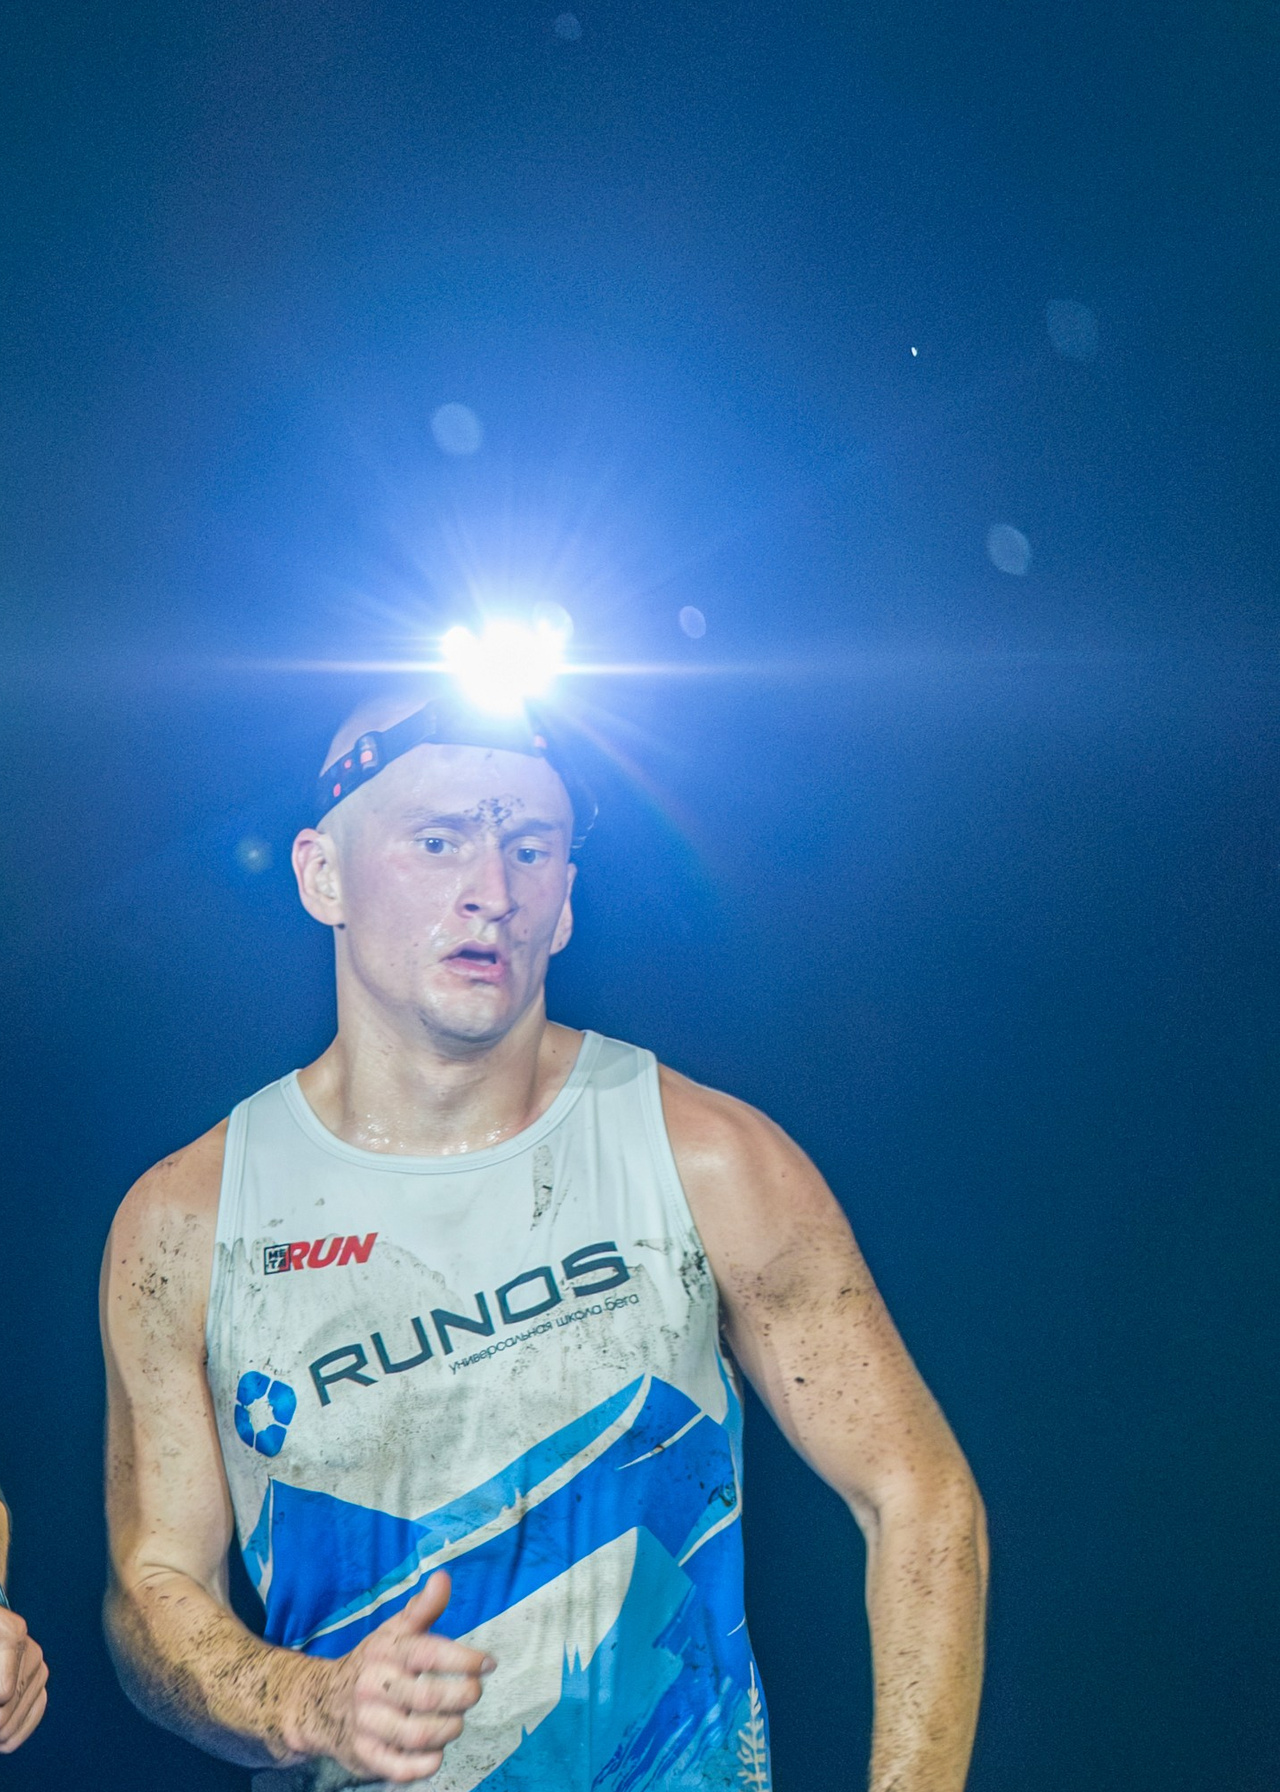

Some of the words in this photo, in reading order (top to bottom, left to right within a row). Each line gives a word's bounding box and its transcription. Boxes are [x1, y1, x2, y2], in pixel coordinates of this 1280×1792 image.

[290, 1232, 379, 1271] RUN
[308, 1241, 631, 1407] RUNOS
[449, 1320, 554, 1375] универсальная
[555, 1304, 603, 1328] школа
[604, 1292, 640, 1312] бега
